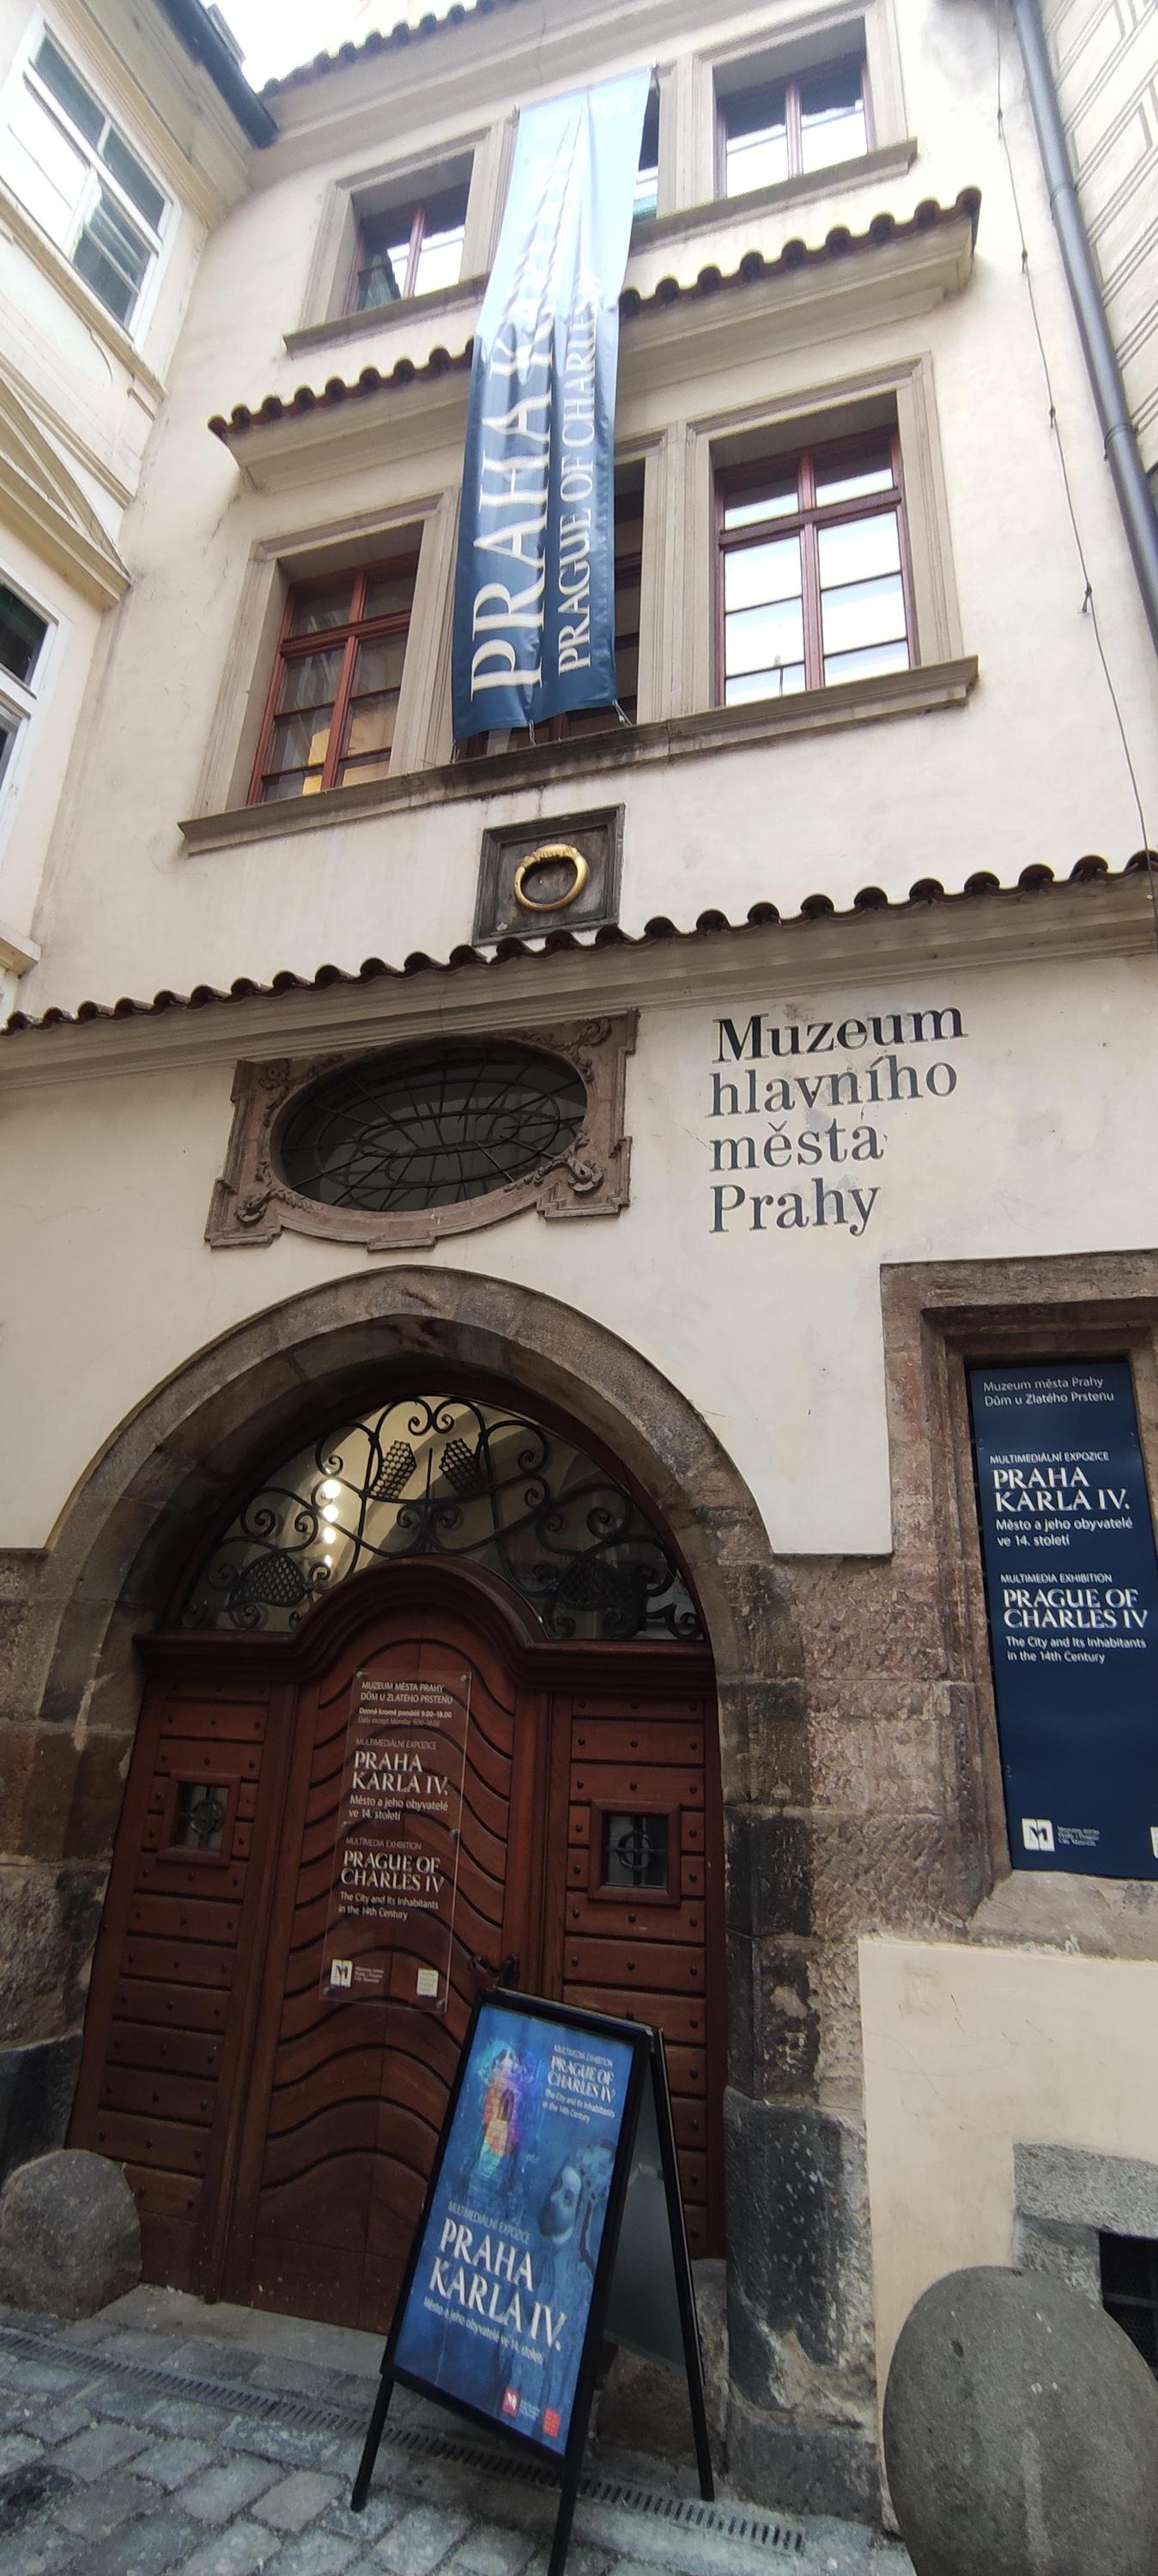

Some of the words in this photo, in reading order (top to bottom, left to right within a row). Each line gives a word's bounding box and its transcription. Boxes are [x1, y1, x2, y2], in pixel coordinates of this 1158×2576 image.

[561, 454, 594, 502] OF
[470, 384, 552, 702] PRAHA
[558, 507, 591, 677] PRAGUE
[712, 1006, 968, 1064] Muzeum
[706, 1054, 957, 1116] hlavního
[709, 1118, 884, 1172] města
[709, 1177, 881, 1236] Prahy
[983, 1381, 1031, 1392] Muzeum
[1034, 1377, 1069, 1389] města
[1072, 1376, 1104, 1388] Prahy
[985, 1394, 1011, 1407] Dům
[1015, 1396, 1022, 1406] u
[1025, 1392, 1069, 1405] Zlatého
[1071, 1391, 1114, 1402] Prstenu
[990, 1451, 1062, 1465] MULTIMEDIÁLNÍ
[1064, 1450, 1110, 1462] EXPOZICE
[991, 1465, 1091, 1489] PRAHA
[994, 1489, 1093, 1512] KARLA
[1096, 1488, 1131, 1510] IV.
[996, 1518, 1031, 1531] Město
[1034, 1522, 1042, 1531] a
[1044, 1517, 1071, 1533] jeho
[1074, 1516, 1133, 1532] obyvatelé
[997, 1537, 1011, 1546] ve
[1015, 1534, 1030, 1546] 14.
[1034, 1534, 1070, 1546] století
[1000, 1573, 1058, 1583] MULTIMEDIA
[1059, 1573, 1113, 1583] EXHIBITION
[1003, 1589, 1100, 1608] PRAGUE
[1105, 1589, 1139, 1608] OF
[1003, 1608, 1117, 1629] CHARLES
[1123, 1609, 1149, 1629] IV
[1005, 1635, 1025, 1648] The
[1027, 1635, 1048, 1649] City
[1050, 1636, 1070, 1648] and
[1087, 1637, 1147, 1649] Inhabitants
[1007, 1650, 1017, 1661] in
[1019, 1650, 1037, 1662] the
[1040, 1650, 1062, 1662] 14th
[1064, 1650, 1106, 1664] Century
[361, 1681, 394, 1691] MUZEUM
[395, 1682, 419, 1692] MĚSTA
[419, 1683, 445, 1692] PRAHY
[361, 1691, 378, 1701] DŮM
[379, 1692, 385, 1701] U
[386, 1693, 419, 1703] ZLATÉHO
[420, 1695, 453, 1704] PRSTENU
[359, 1706, 378, 1715] Denně
[356, 1738, 405, 1747] MULTIMEDIÁLNÍ
[406, 1740, 437, 1750] EXPOZICE
[354, 1750, 423, 1772] PRAHA
[352, 1771, 421, 1794] KARLA
[426, 1775, 448, 1795] IV.
[349, 1794, 376, 1806] Město
[384, 1797, 404, 1809] jeho
[406, 1799, 448, 1812] obyvatelé
[349, 1809, 359, 1818] ve
[361, 1808, 373, 1819] 14.
[374, 1810, 402, 1820] století
[346, 1837, 385, 1847] MULTIMEDIA
[385, 1839, 421, 1850] EXHIBITION
[343, 1850, 412, 1872] PRAGUE
[416, 1856, 440, 1874] OF
[341, 1868, 421, 1892] CHARLES
[426, 1874, 445, 1893] IV
[341, 1891, 354, 1901] The
[355, 1893, 370, 1904] City
[371, 1895, 385, 1905] and
[397, 1897, 440, 1910] Inhabitants
[347, 1905, 360, 1914] the
[361, 1906, 378, 1917] 14th
[379, 1907, 409, 1922] Century
[551, 2056, 597, 2082] PRAGUE
[597, 2069, 615, 2087] OF
[440, 2216, 534, 2293] PRAHA
[428, 2256, 523, 2334] KARLA
[530, 2300, 568, 2352] IV.
